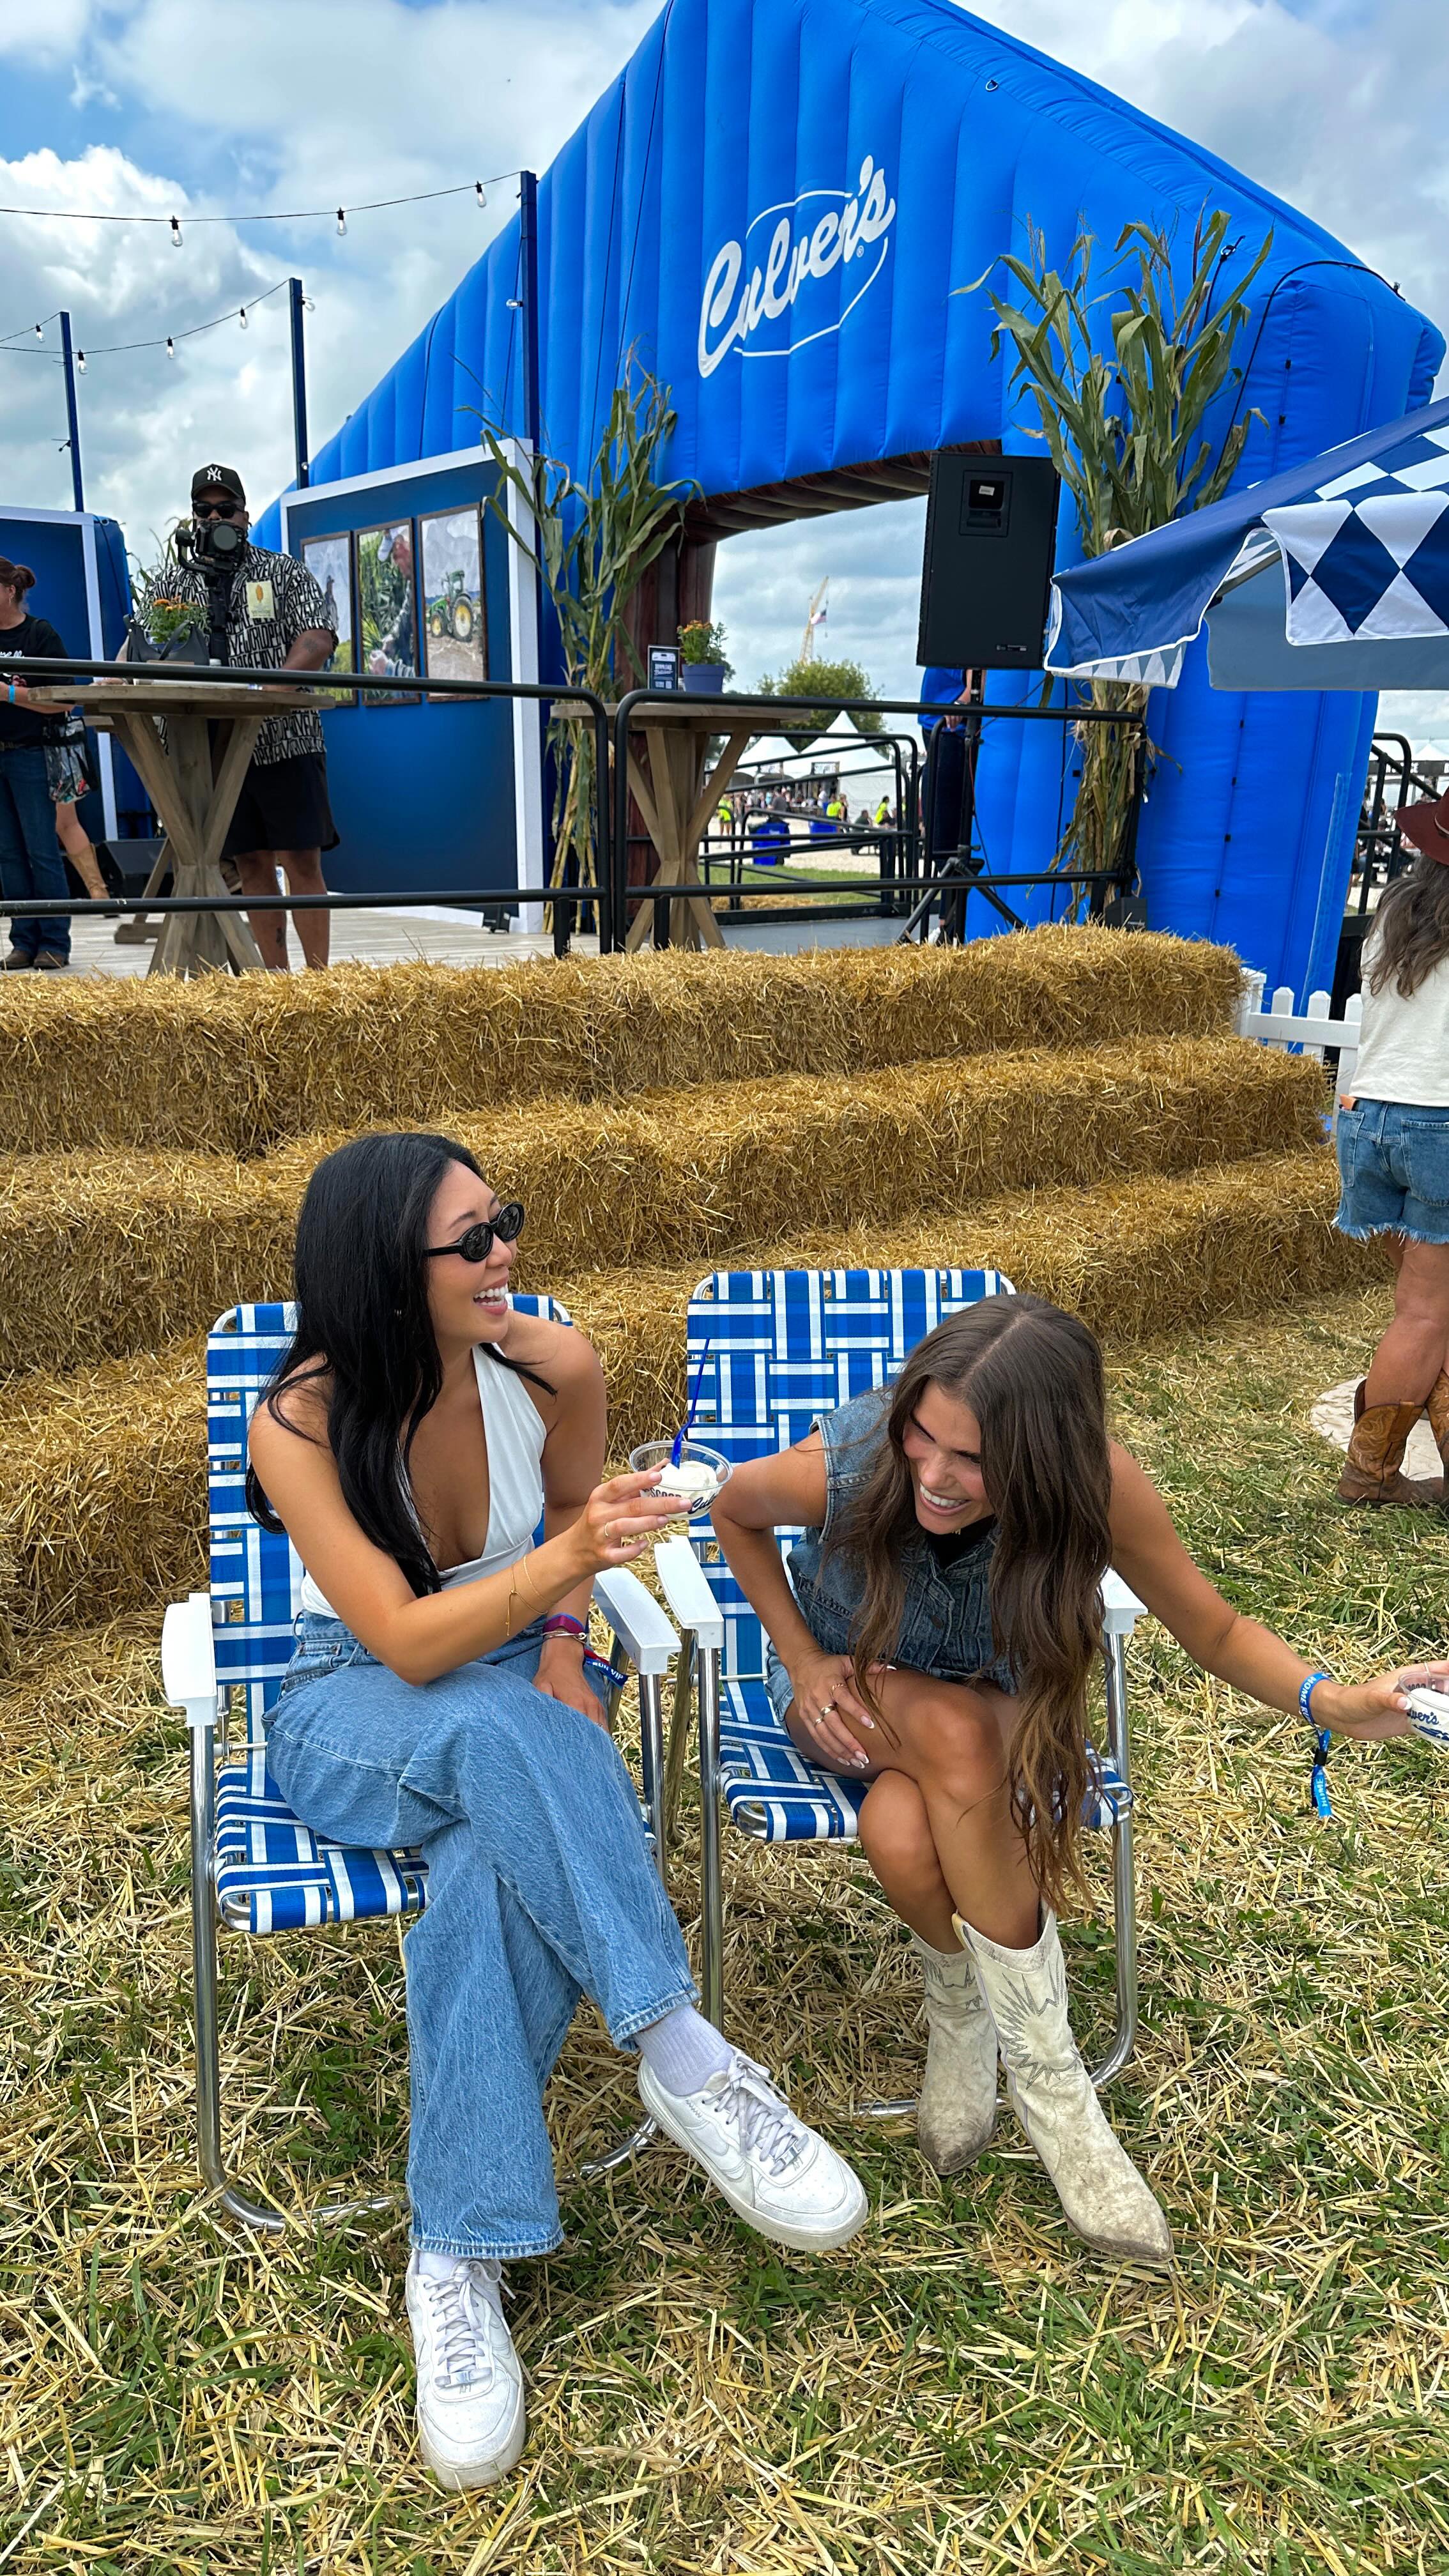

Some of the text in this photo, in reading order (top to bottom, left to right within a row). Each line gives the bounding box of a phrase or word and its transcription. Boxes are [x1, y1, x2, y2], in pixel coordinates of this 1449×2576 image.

[698, 155, 896, 378] Culver's
[206, 467, 222, 481] NY
[611, 1668, 624, 1680] VIP
[1300, 1676, 1317, 1705] HOME
